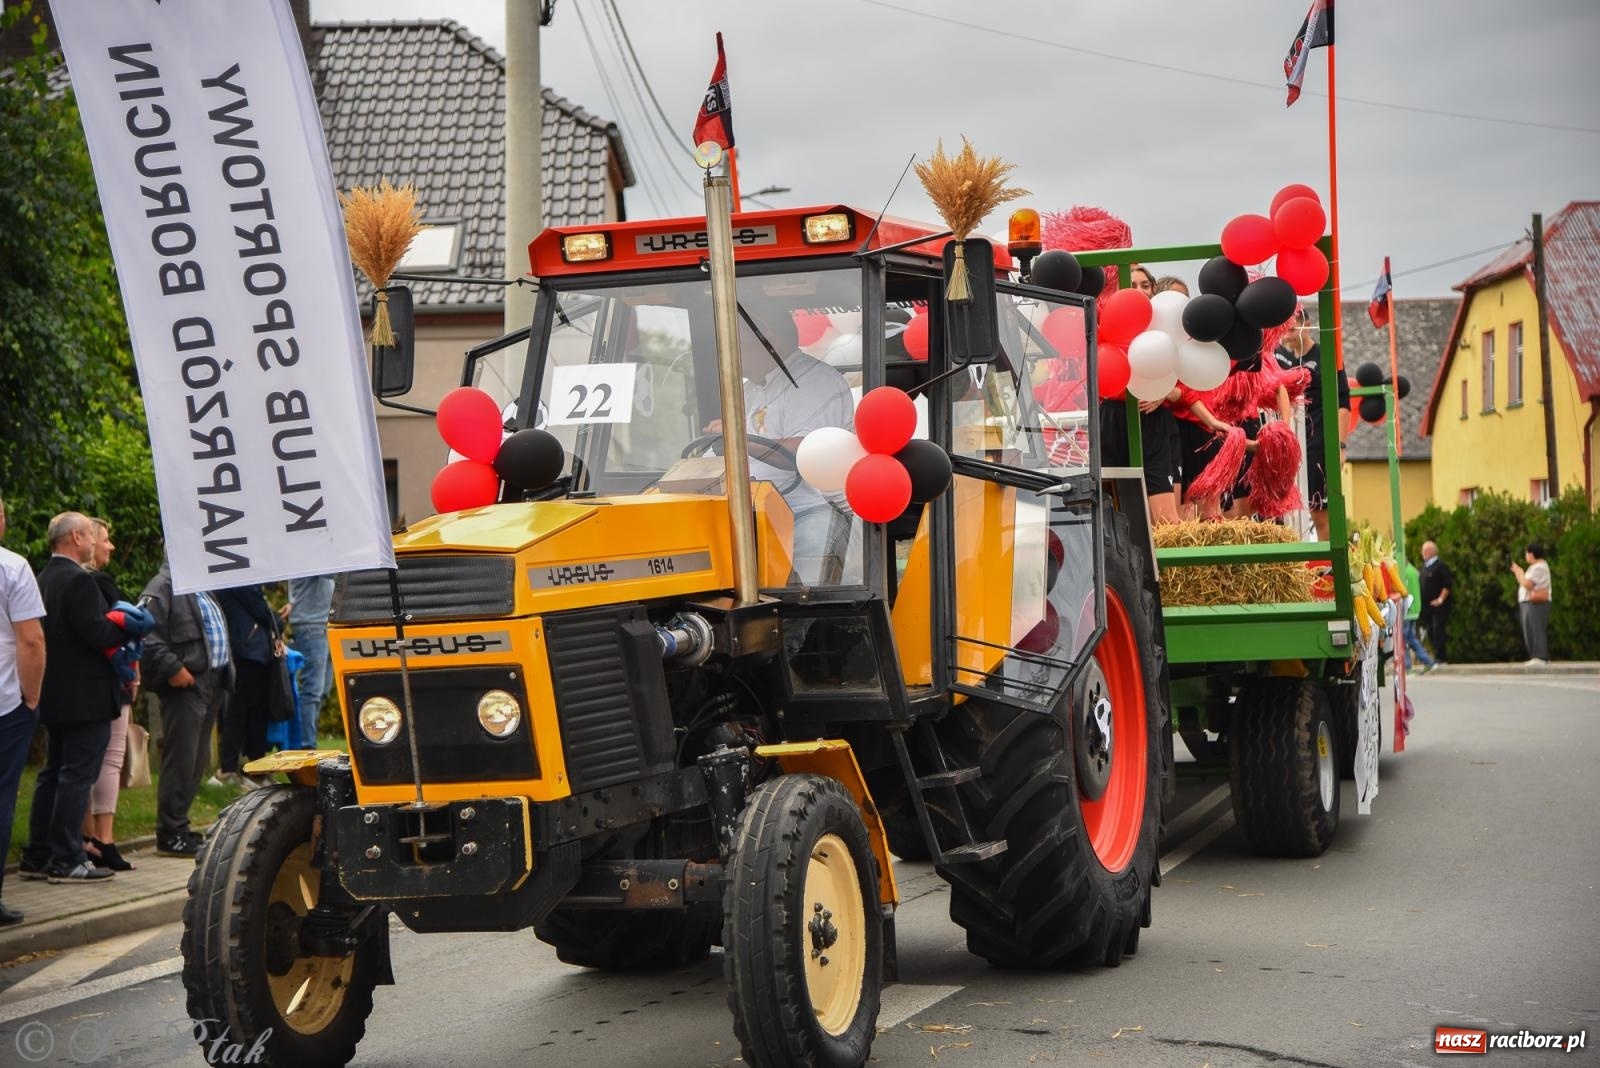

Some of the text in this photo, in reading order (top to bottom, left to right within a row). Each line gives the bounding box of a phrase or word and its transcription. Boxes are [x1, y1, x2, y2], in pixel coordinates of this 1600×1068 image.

[644, 228, 768, 252] URSS
[566, 383, 613, 419] 22
[548, 557, 675, 586] URSUS 1614
